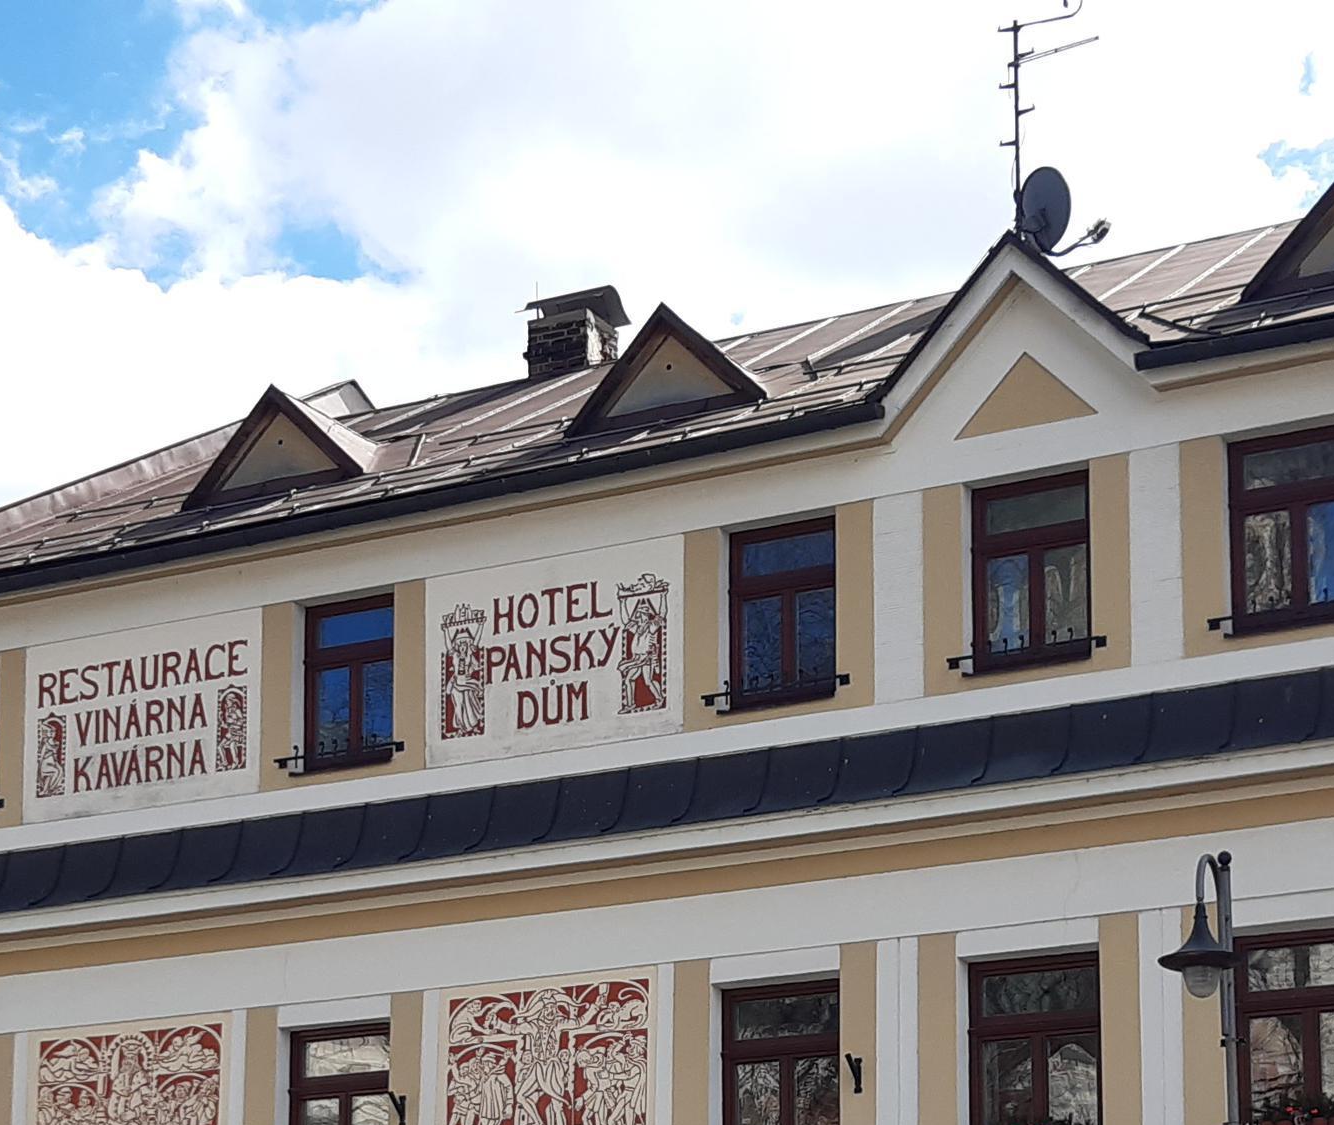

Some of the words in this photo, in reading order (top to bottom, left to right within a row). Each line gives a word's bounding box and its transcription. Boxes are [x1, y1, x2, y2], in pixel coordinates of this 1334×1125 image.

[491, 580, 613, 636] HOTEL
[36, 639, 250, 710] RESTAURACE
[485, 624, 621, 685] PANSKÝ
[73, 692, 209, 747] VINÁRNA
[516, 679, 590, 730] DŮM
[71, 738, 208, 794] KAVÁRNA
